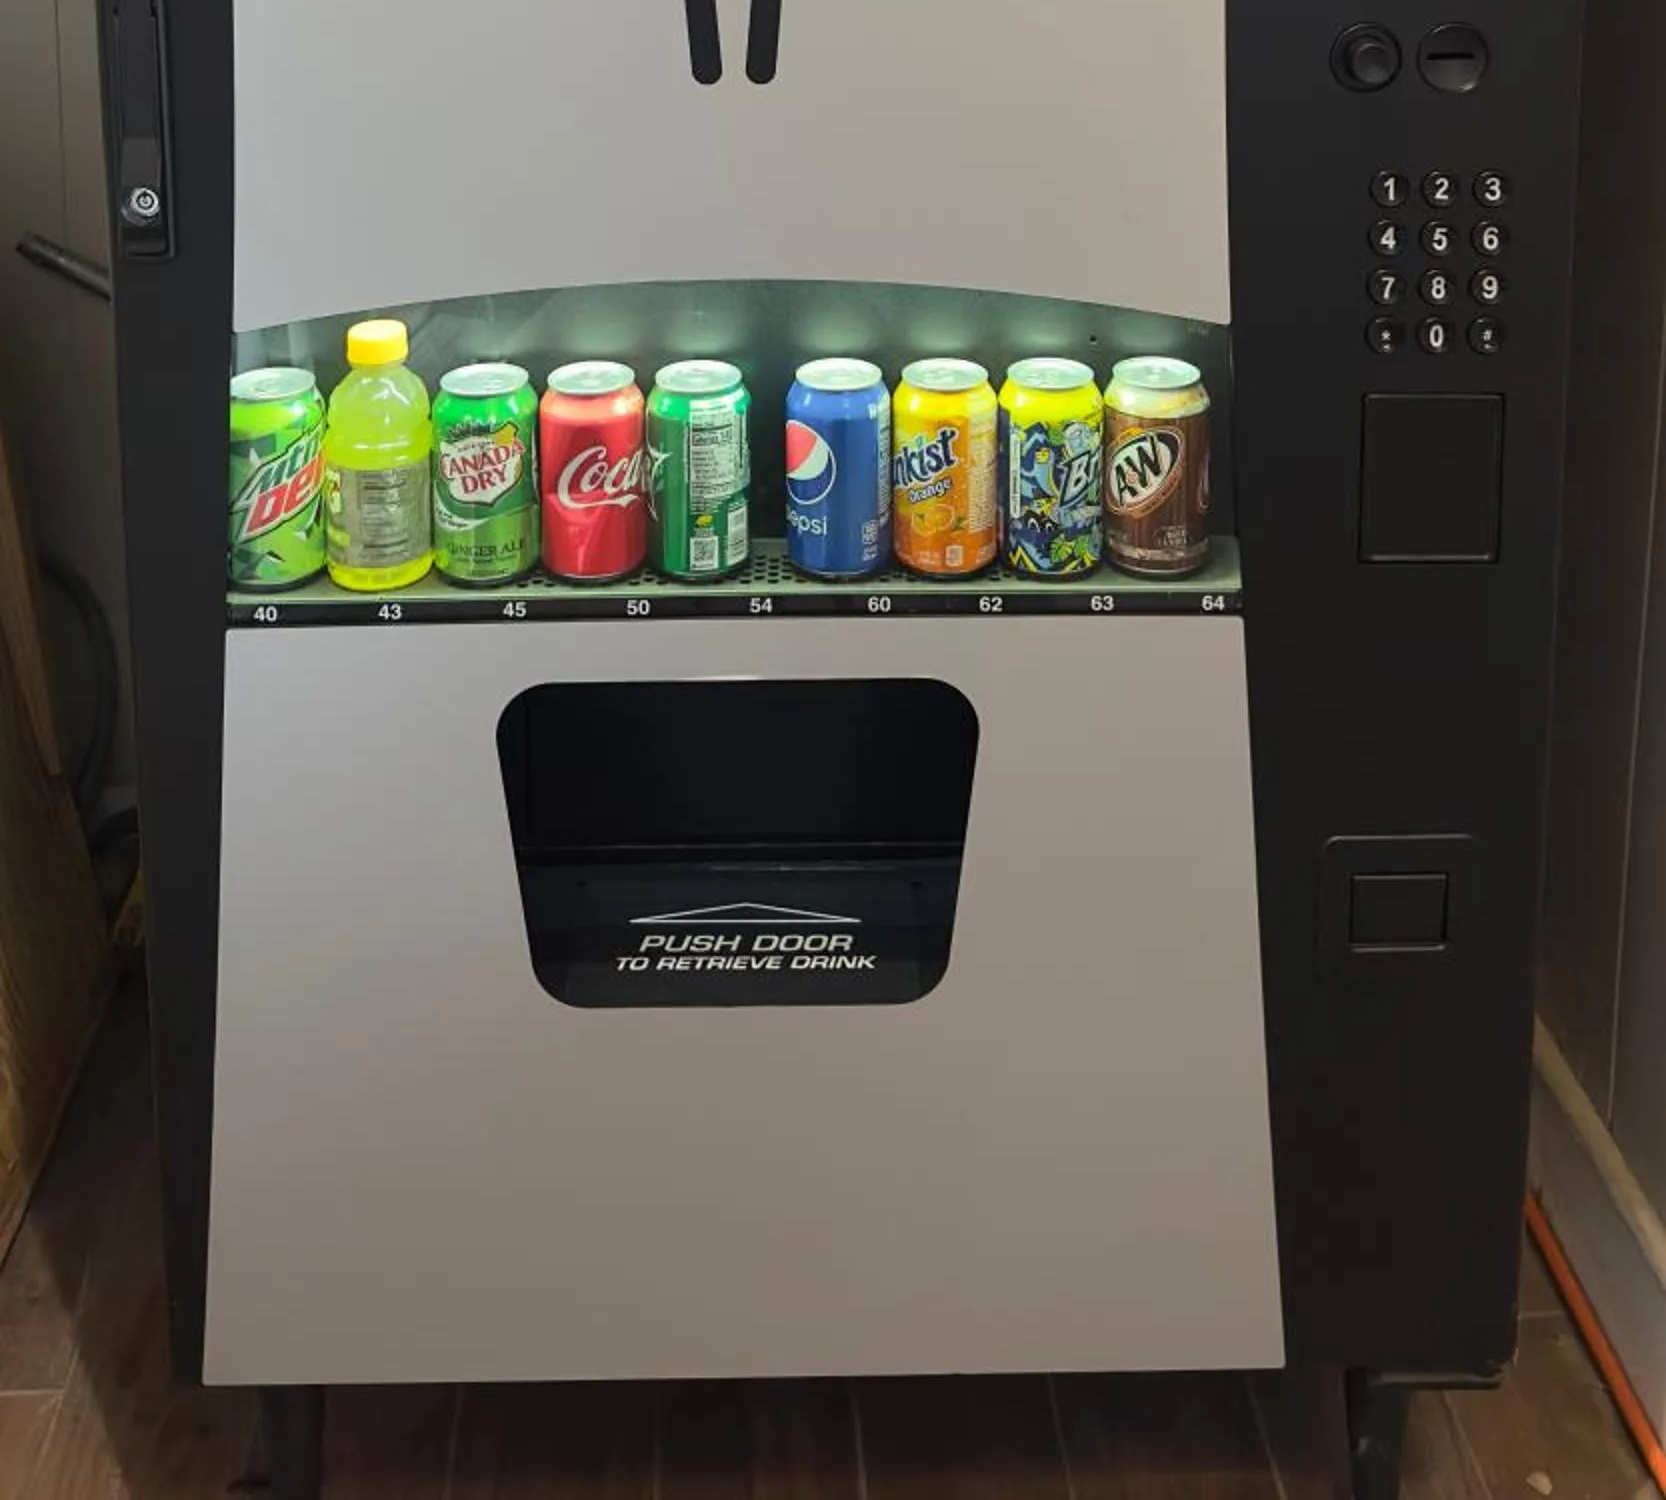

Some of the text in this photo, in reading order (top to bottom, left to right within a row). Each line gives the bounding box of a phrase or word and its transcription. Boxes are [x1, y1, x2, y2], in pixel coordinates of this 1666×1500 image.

[1384, 177, 1395, 201] 1
[1434, 177, 1449, 200] 2
[1484, 177, 1501, 201] 3
[1379, 226, 1396, 250] 4
[1432, 227, 1448, 251] 5
[1483, 227, 1499, 250] 6
[1381, 276, 1396, 299] 7
[1431, 276, 1446, 299] 8
[1482, 275, 1498, 299] 9
[1429, 324, 1444, 347] 0
[440, 437, 526, 483] CANADA
[893, 427, 959, 488] nkist
[461, 463, 508, 494] DRY
[253, 606, 277, 622] 40
[378, 604, 402, 620] 43
[503, 602, 527, 617] 45
[627, 600, 650, 615] 50
[750, 598, 773, 613] 54
[867, 596, 891, 612] 60
[979, 596, 1003, 612] 62
[1091, 595, 1115, 611] 63
[1202, 595, 1225, 611] 64
[639, 935, 853, 952] PUSH DOOR
[616, 955, 876, 971] TO RETRIEVE DRINK
